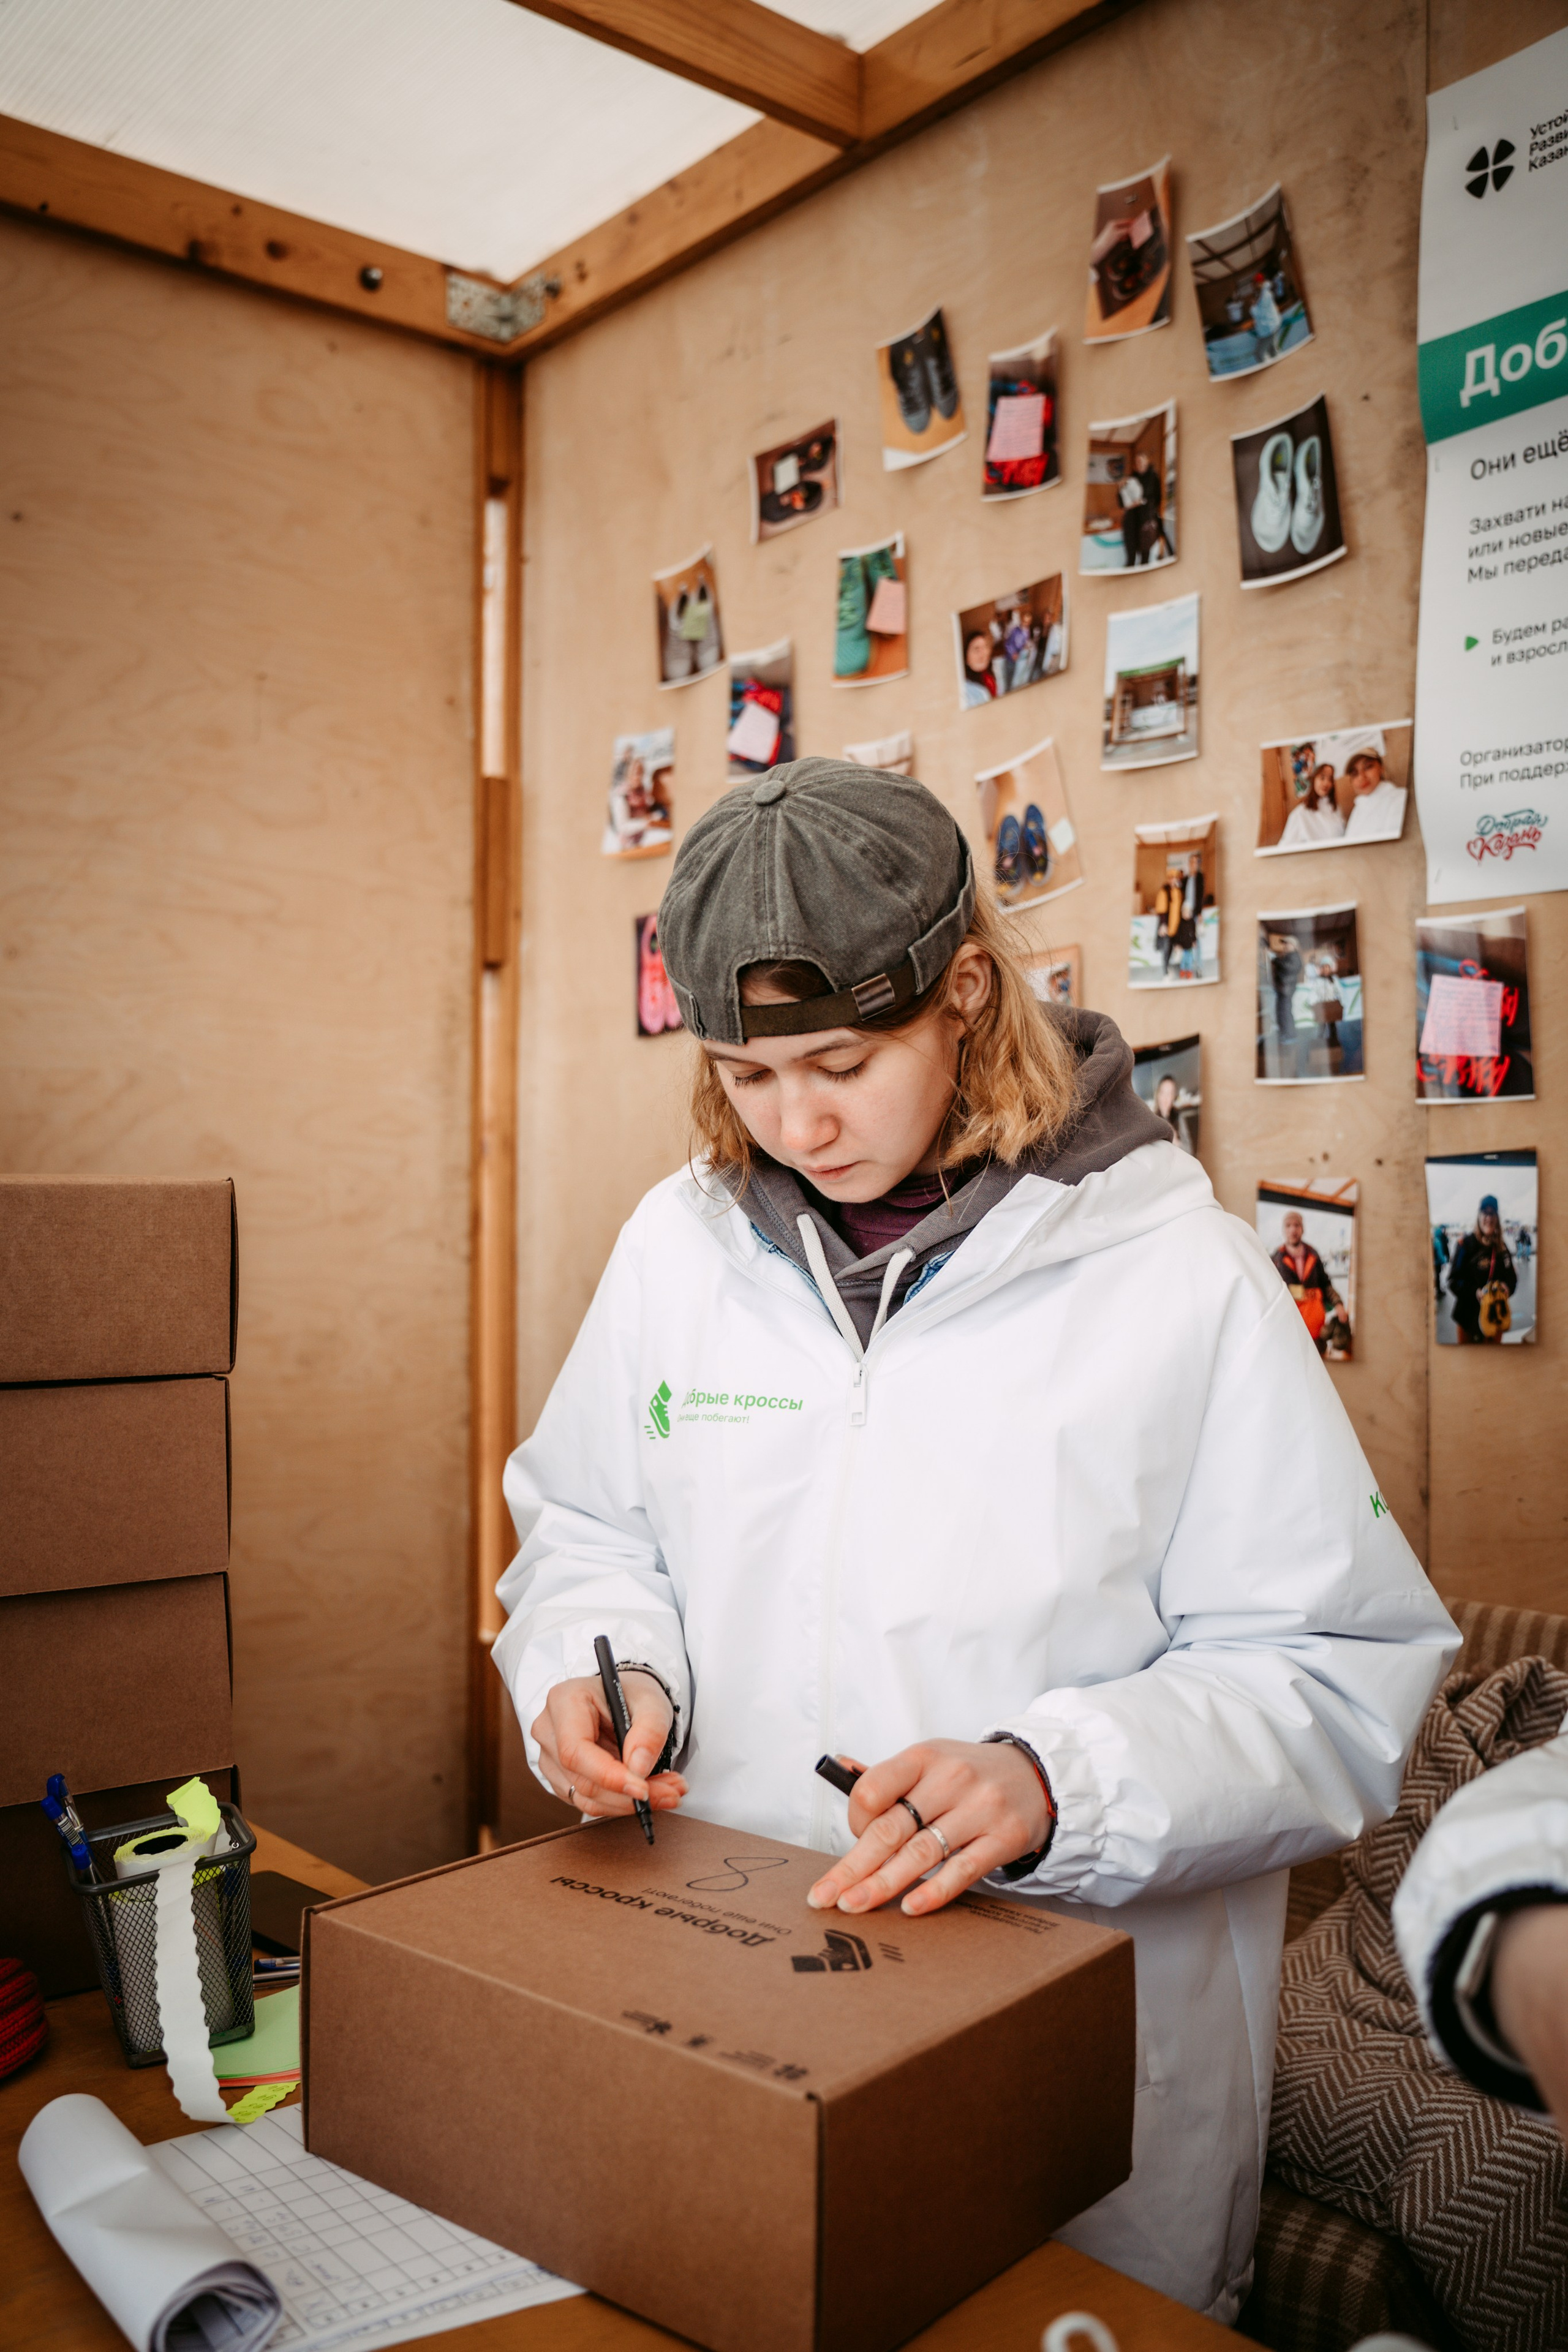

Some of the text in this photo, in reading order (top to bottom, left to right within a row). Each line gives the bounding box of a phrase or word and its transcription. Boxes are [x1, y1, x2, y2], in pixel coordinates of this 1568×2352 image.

[1460, 317, 1567, 408] Доб
[1471, 429, 1568, 480] Они ещё
[1469, 502, 1546, 535] Захвати
[1468, 522, 1568, 559] или новые
[1468, 565, 1498, 582] Мы
[1492, 622, 1546, 646] Будем
[1491, 639, 1567, 667] и взросл
[1460, 772, 1493, 790] При
[733, 1393, 803, 1411] кроссы
[701, 1412, 750, 1423] побегают!
[550, 1876, 776, 1947] Добрые кроссы
[641, 1888, 721, 1913] побегают!
[758, 1921, 792, 1936] Они
